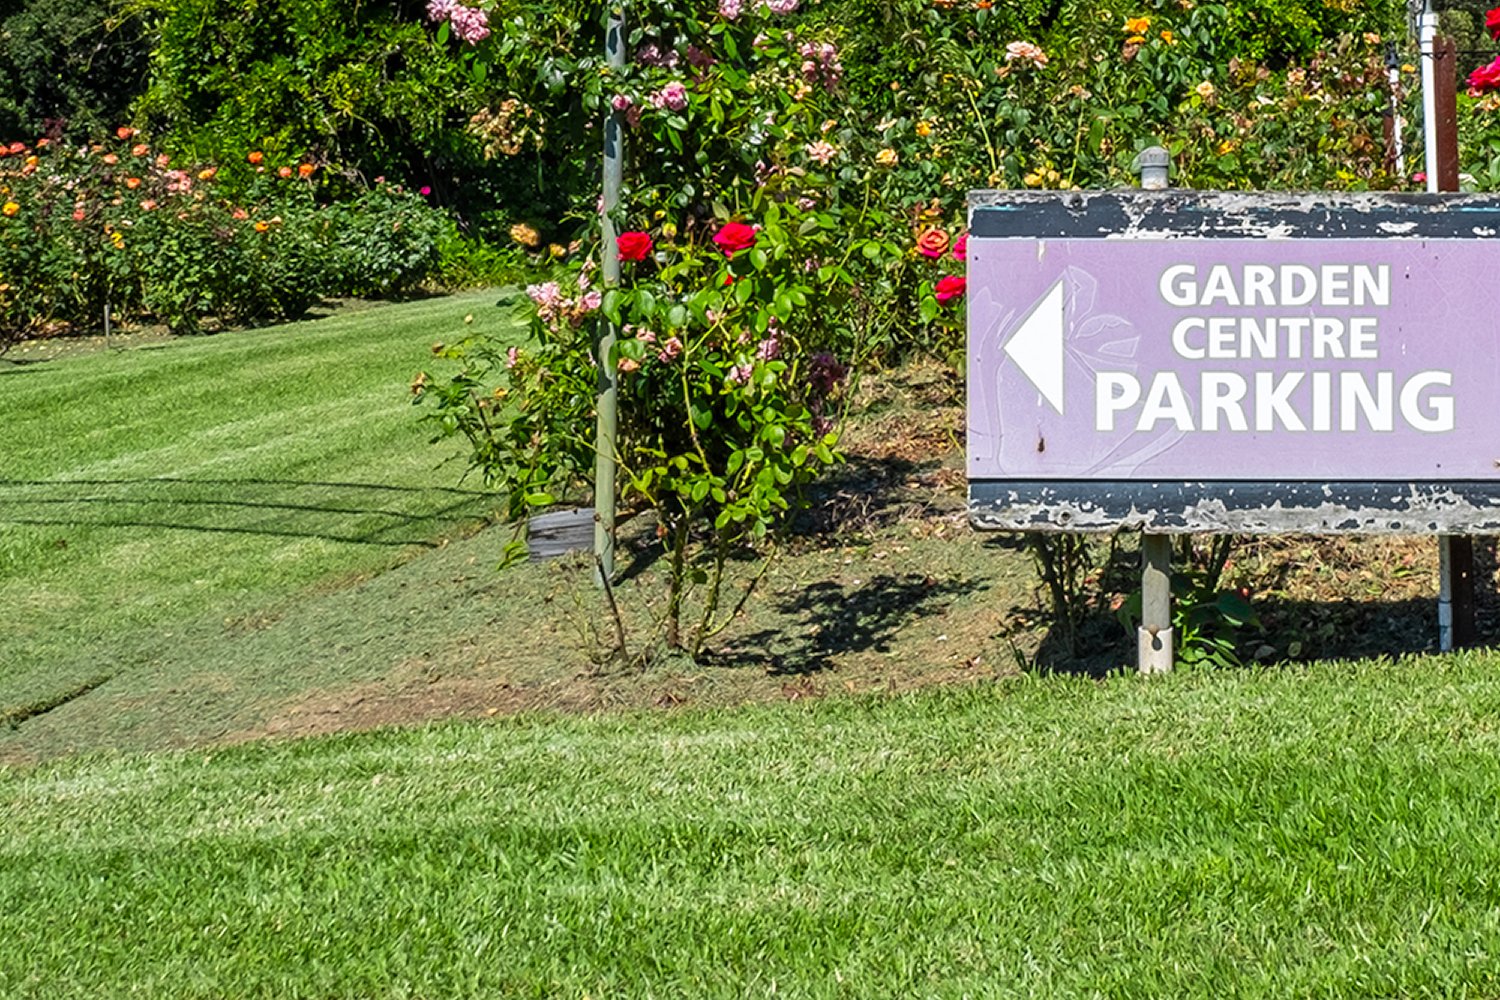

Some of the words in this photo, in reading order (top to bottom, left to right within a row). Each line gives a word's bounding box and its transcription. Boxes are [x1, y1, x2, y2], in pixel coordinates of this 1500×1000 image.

[1159, 263, 1390, 307] GARDEN
[1171, 317, 1379, 360] CENTRE
[1094, 371, 1456, 433] PARKING
